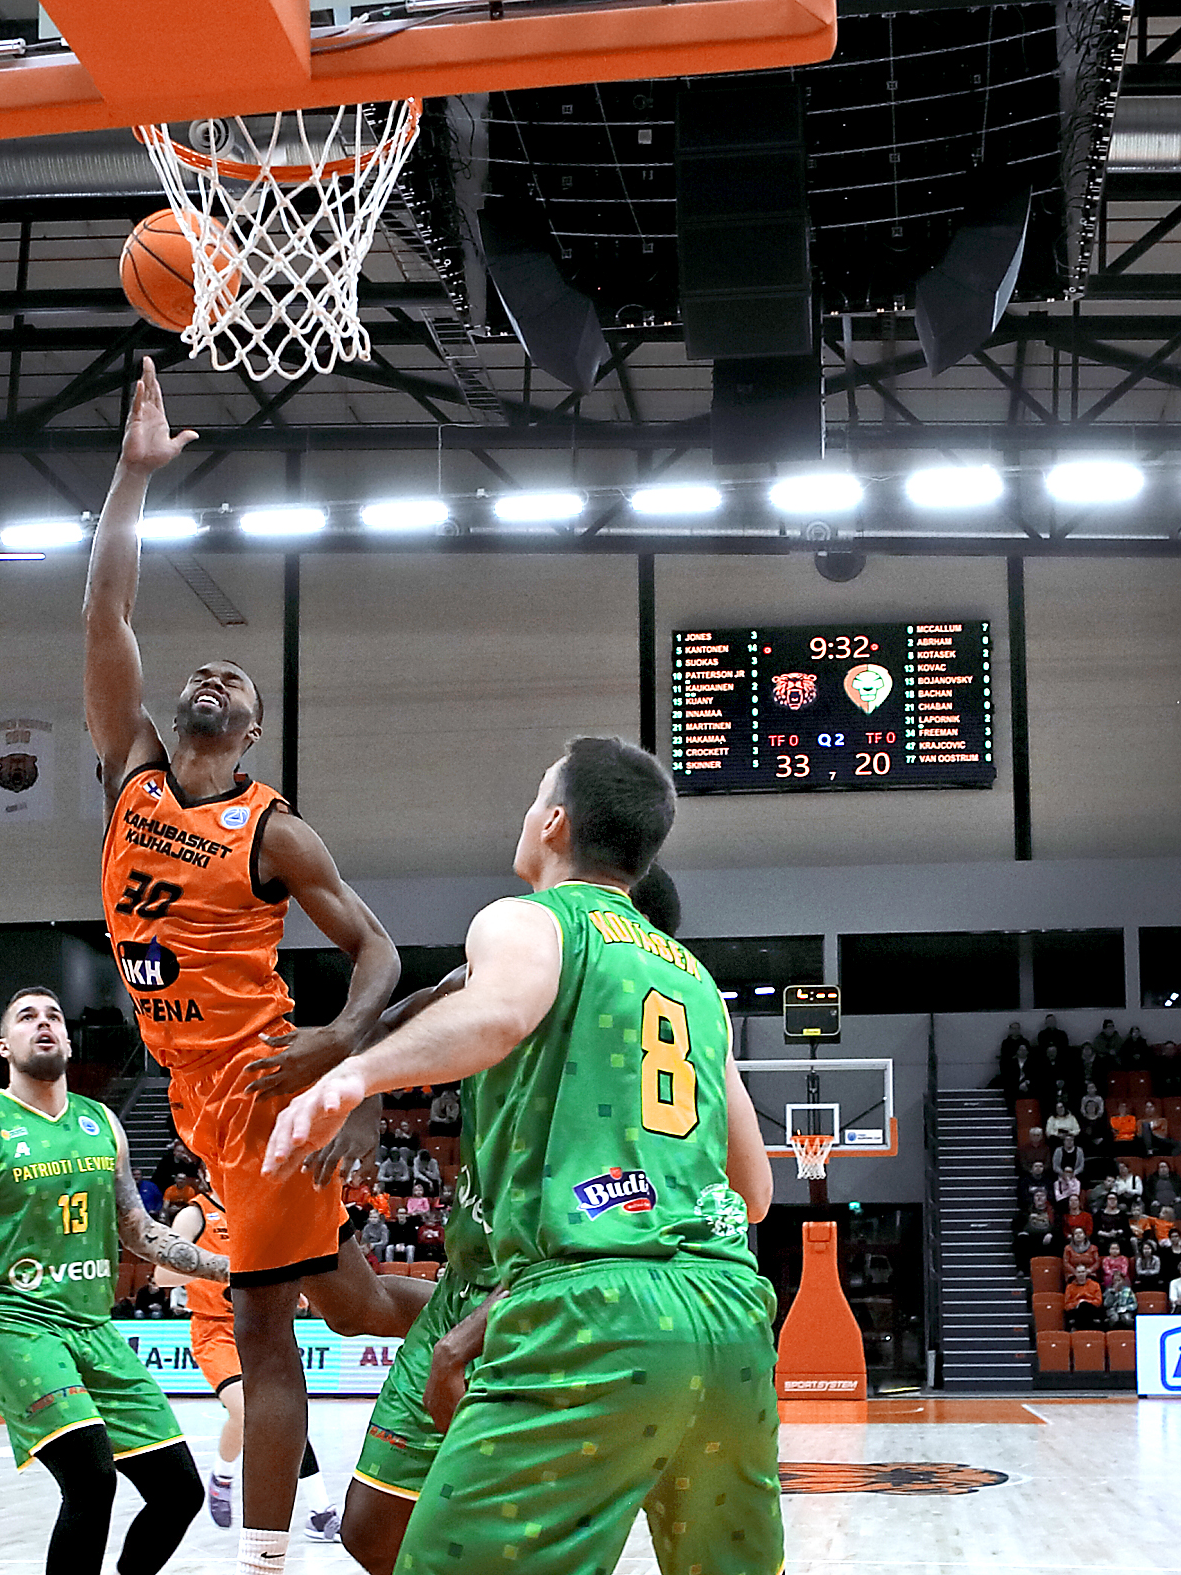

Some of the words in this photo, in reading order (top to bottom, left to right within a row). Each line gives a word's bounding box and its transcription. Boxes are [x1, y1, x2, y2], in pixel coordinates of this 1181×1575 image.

[982, 623, 988, 631] 7
[685, 633, 712, 641] JONES
[751, 631, 757, 639] 3
[810, 635, 870, 660] 9:32
[685, 671, 733, 679] PATTERSON
[734, 670, 745, 678] JR
[918, 664, 946, 672] KOVAC
[768, 735, 785, 746] TF
[789, 735, 799, 746] 0
[865, 732, 882, 744] TF
[886, 731, 896, 743] 0
[686, 747, 729, 756] CROCKETT
[855, 752, 890, 775] 20
[906, 755, 916, 763] 77
[776, 754, 810, 778] 33
[115, 868, 184, 918] 30
[641, 987, 700, 1139] 8
[12, 1159, 73, 1183] PATRIOTI
[57, 1191, 89, 1235] 13
